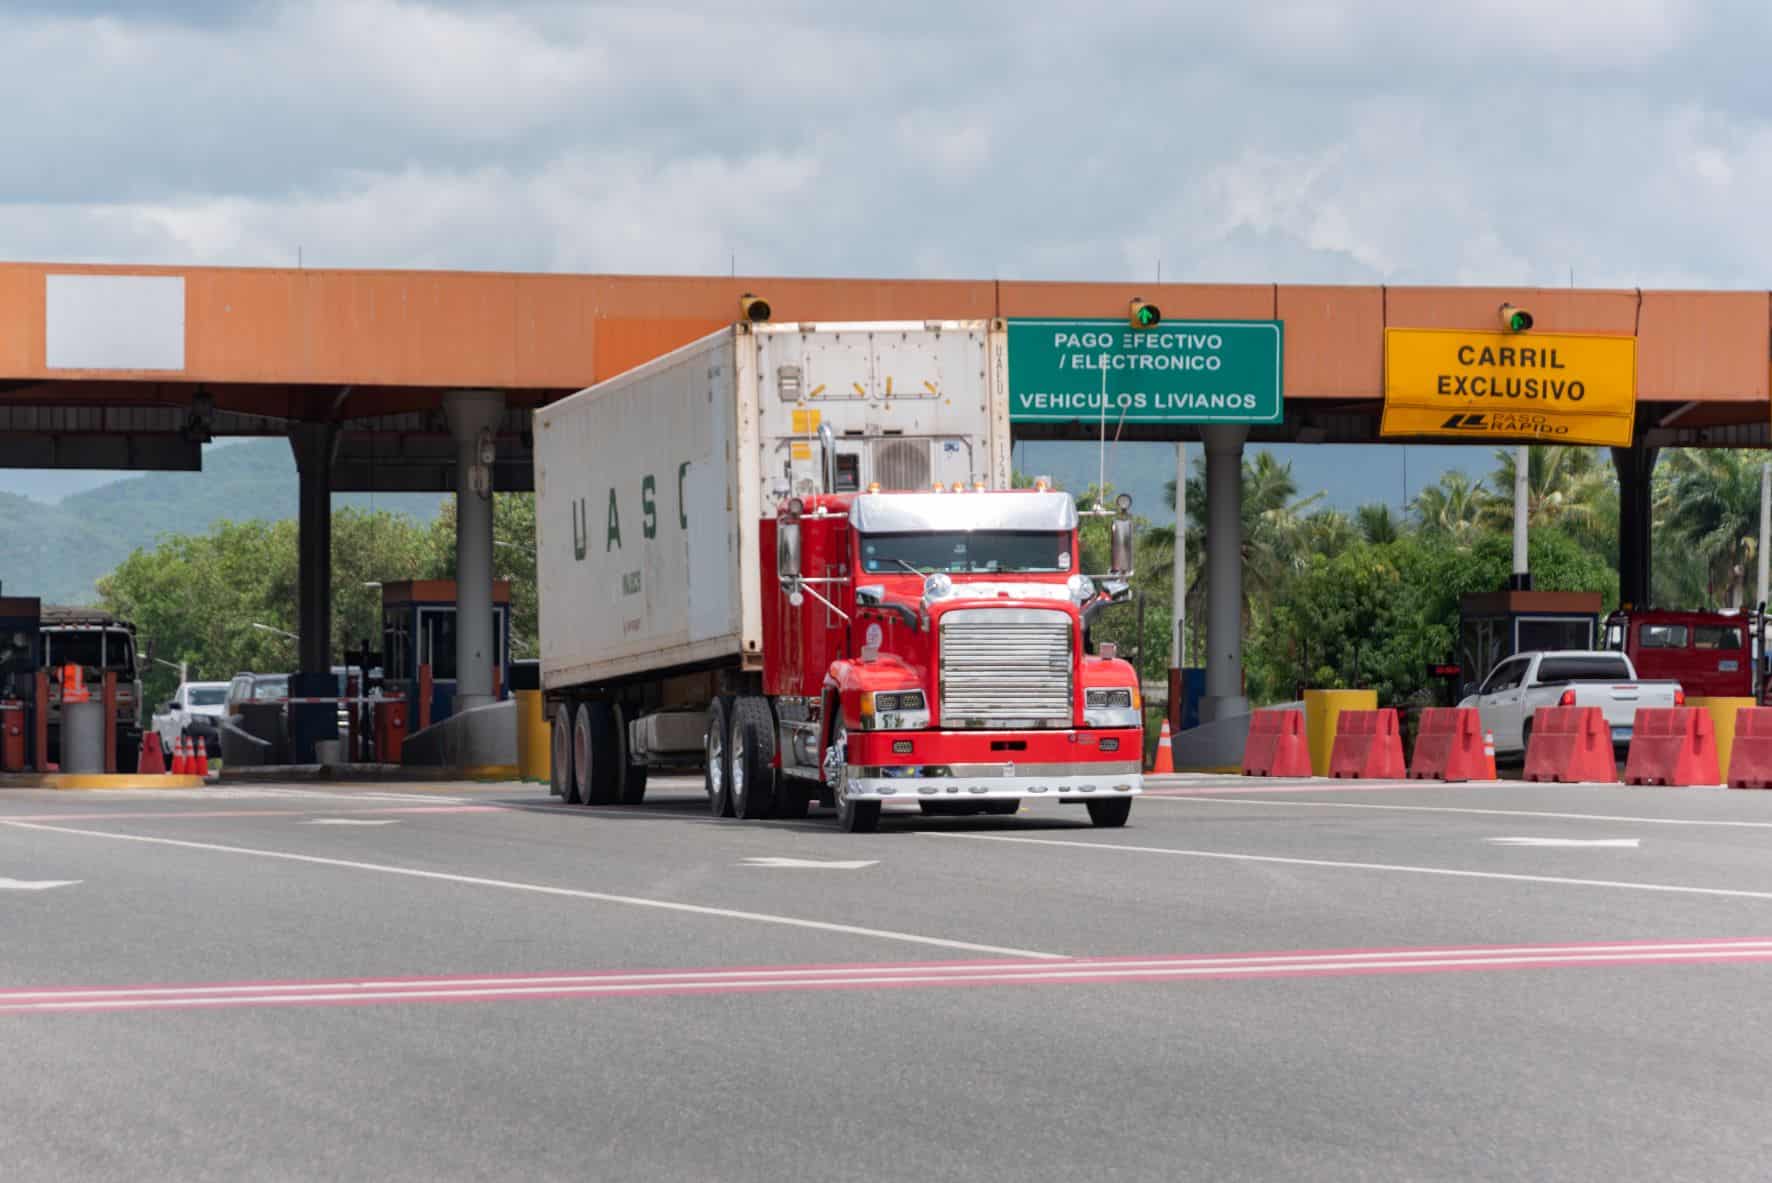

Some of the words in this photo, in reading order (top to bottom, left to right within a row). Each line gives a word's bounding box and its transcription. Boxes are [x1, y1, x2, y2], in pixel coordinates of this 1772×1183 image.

[1054, 333, 1113, 349] PAGO
[1122, 334, 1223, 350] EFECTIVO
[1457, 345, 1566, 369] CARRIL
[1437, 375, 1586, 401] EXCLUSIVO
[1019, 393, 1147, 409] VEHICULOS
[1154, 393, 1257, 409] LIVIANOS
[1492, 413, 1546, 423] PASO
